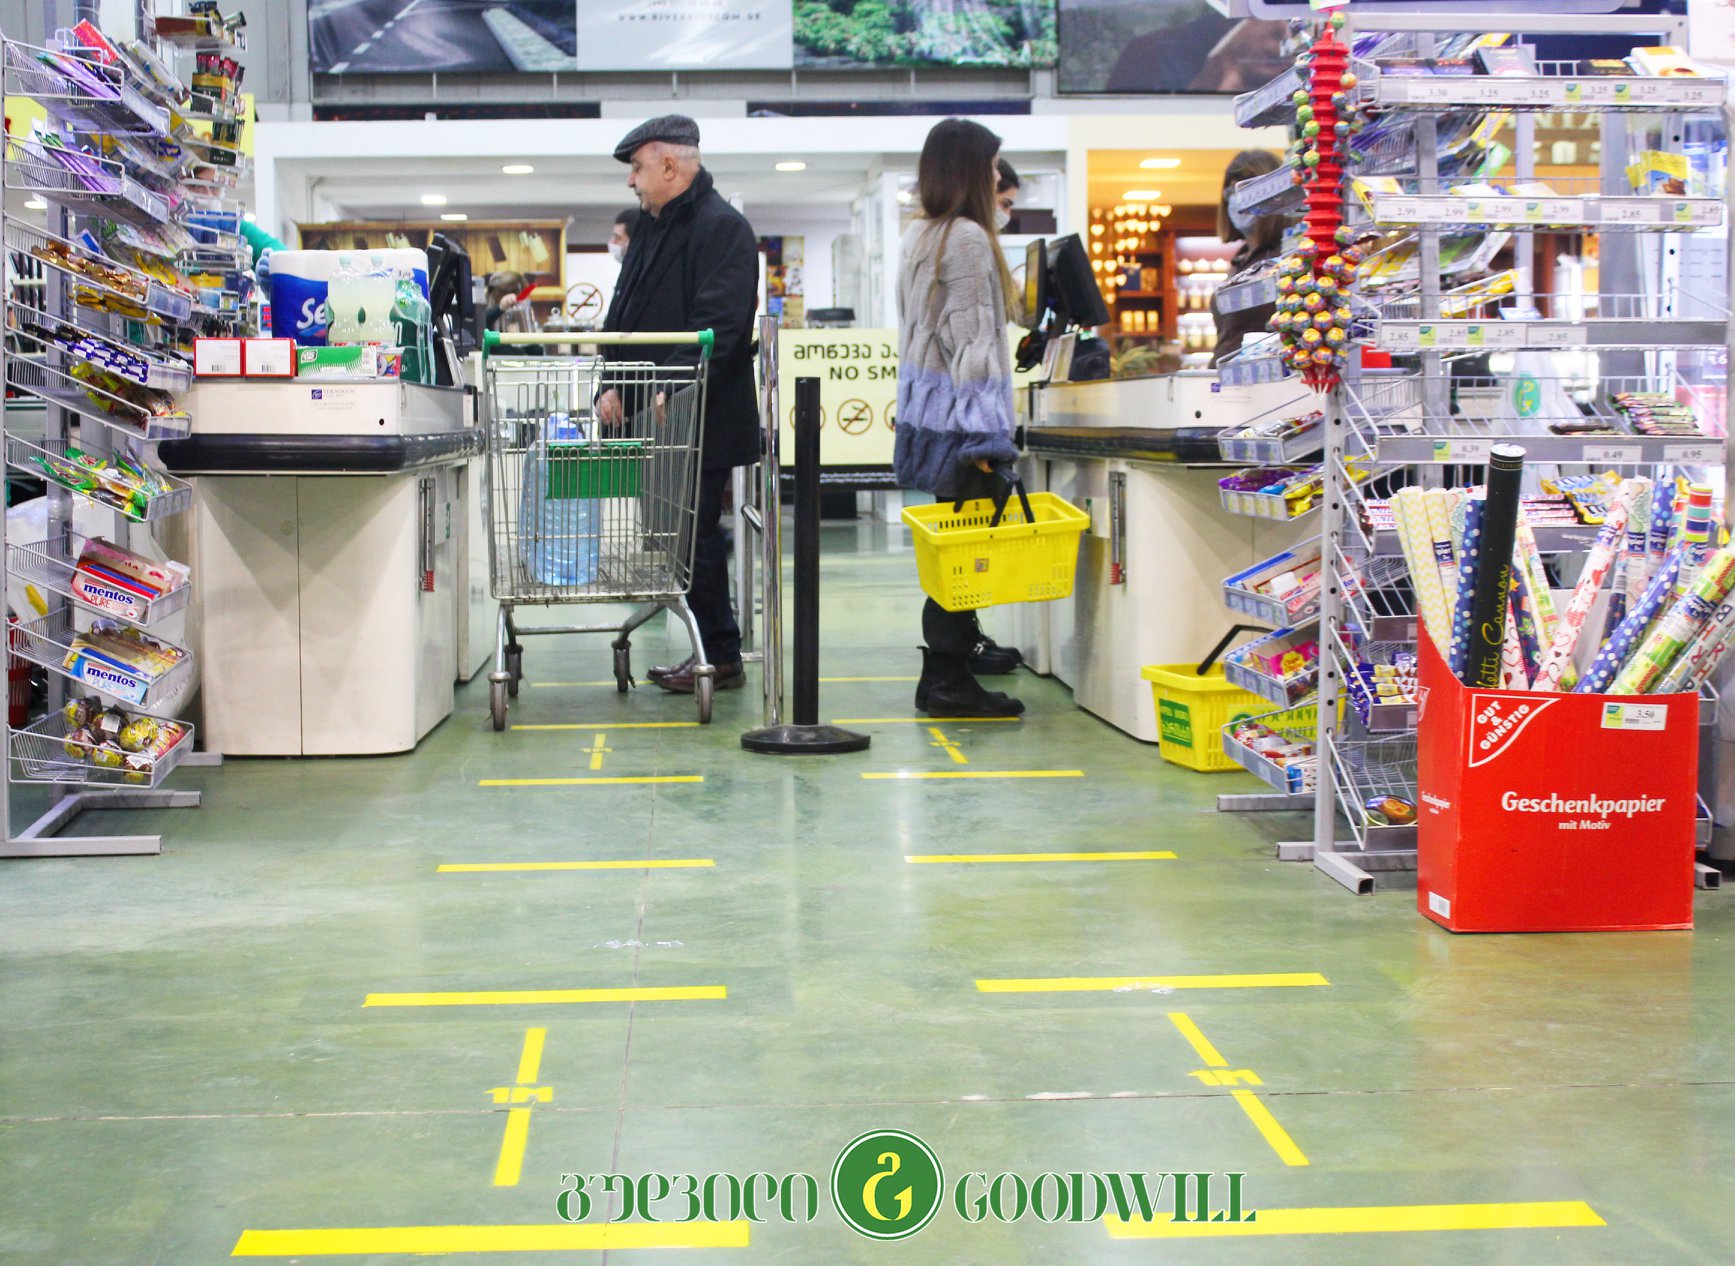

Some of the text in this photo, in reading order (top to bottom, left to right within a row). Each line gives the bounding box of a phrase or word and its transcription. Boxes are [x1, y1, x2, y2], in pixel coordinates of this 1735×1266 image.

[829, 365, 859, 381] NO
[83, 584, 134, 605] mentos
[86, 667, 137, 688] mentos
[1477, 700, 1502, 724] GUT
[1480, 704, 1530, 750] GÜNSTIG
[1501, 790, 1666, 818] Geschenkpapier
[1558, 819, 1611, 830] mit Motiv
